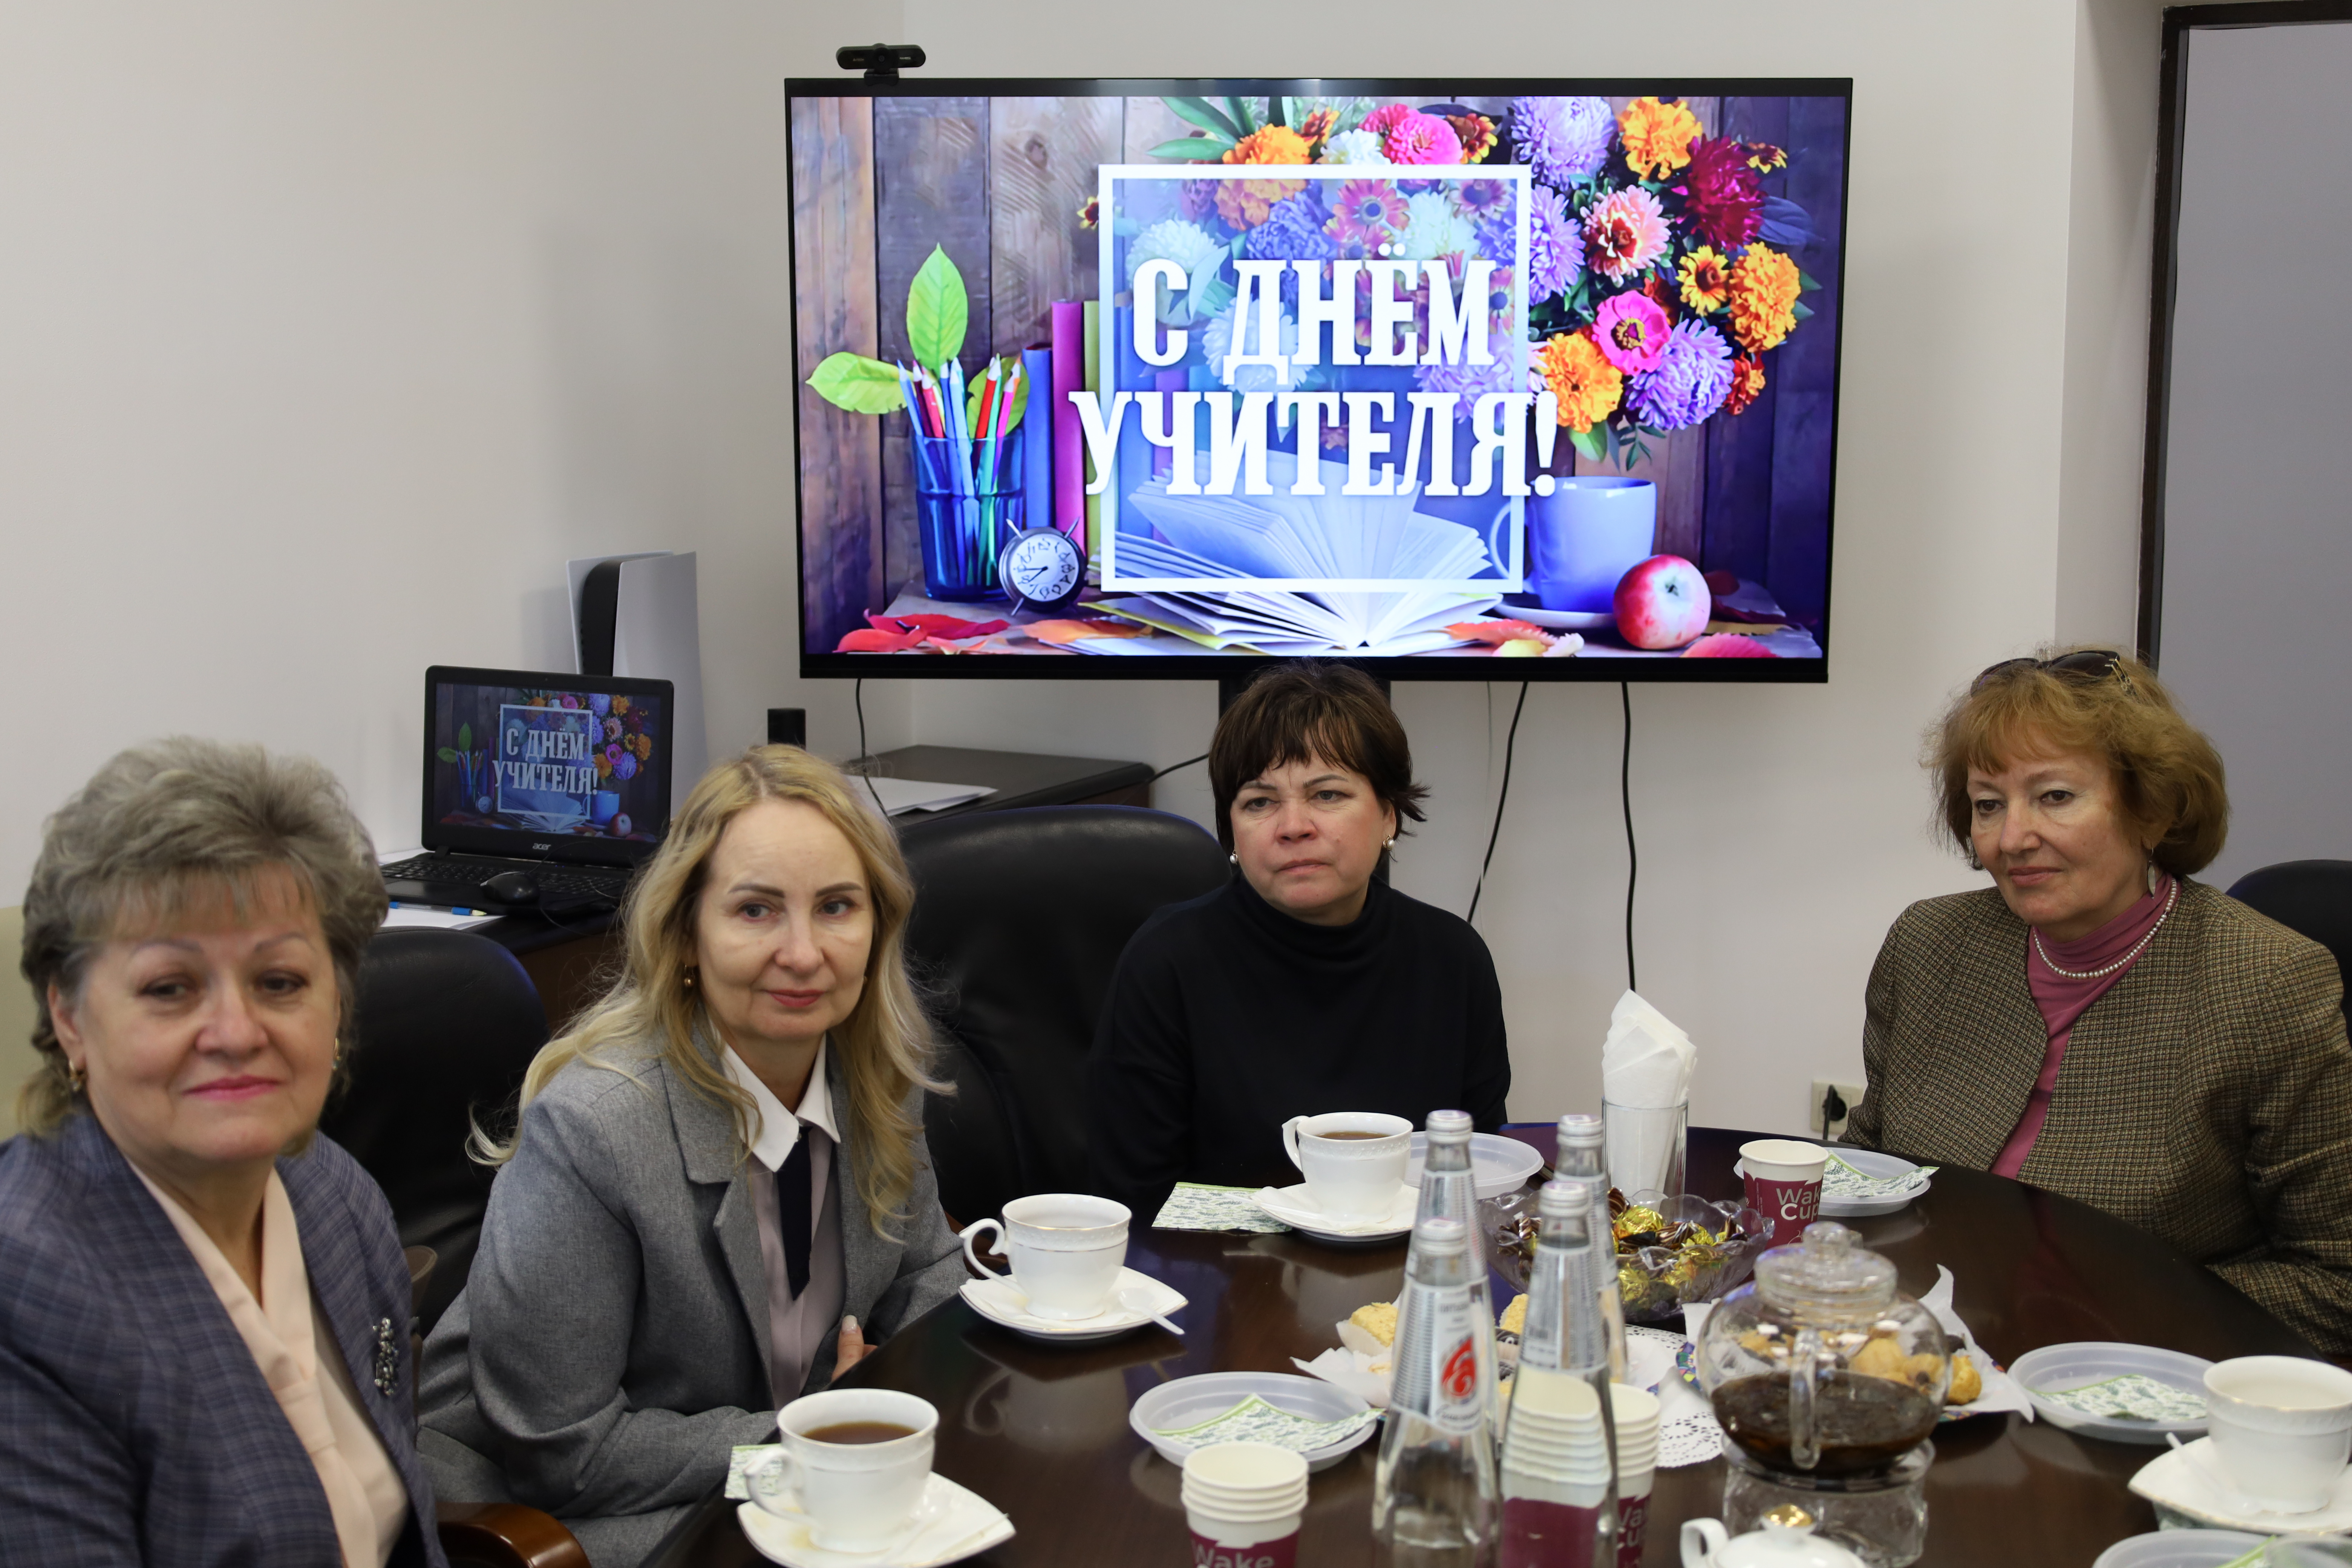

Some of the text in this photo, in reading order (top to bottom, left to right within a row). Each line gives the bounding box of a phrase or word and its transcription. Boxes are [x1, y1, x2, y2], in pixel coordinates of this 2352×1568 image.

[1133, 243, 1496, 385] С ДНЁМ
[1068, 390, 1558, 498] УЧИТЕЛЯ!
[506, 727, 585, 762] С ДНЁМ
[492, 760, 598, 795] УЧИТЕЛЯ!
[1776, 1185, 1820, 1205] Wak
[1781, 1203, 1819, 1222] Cup
